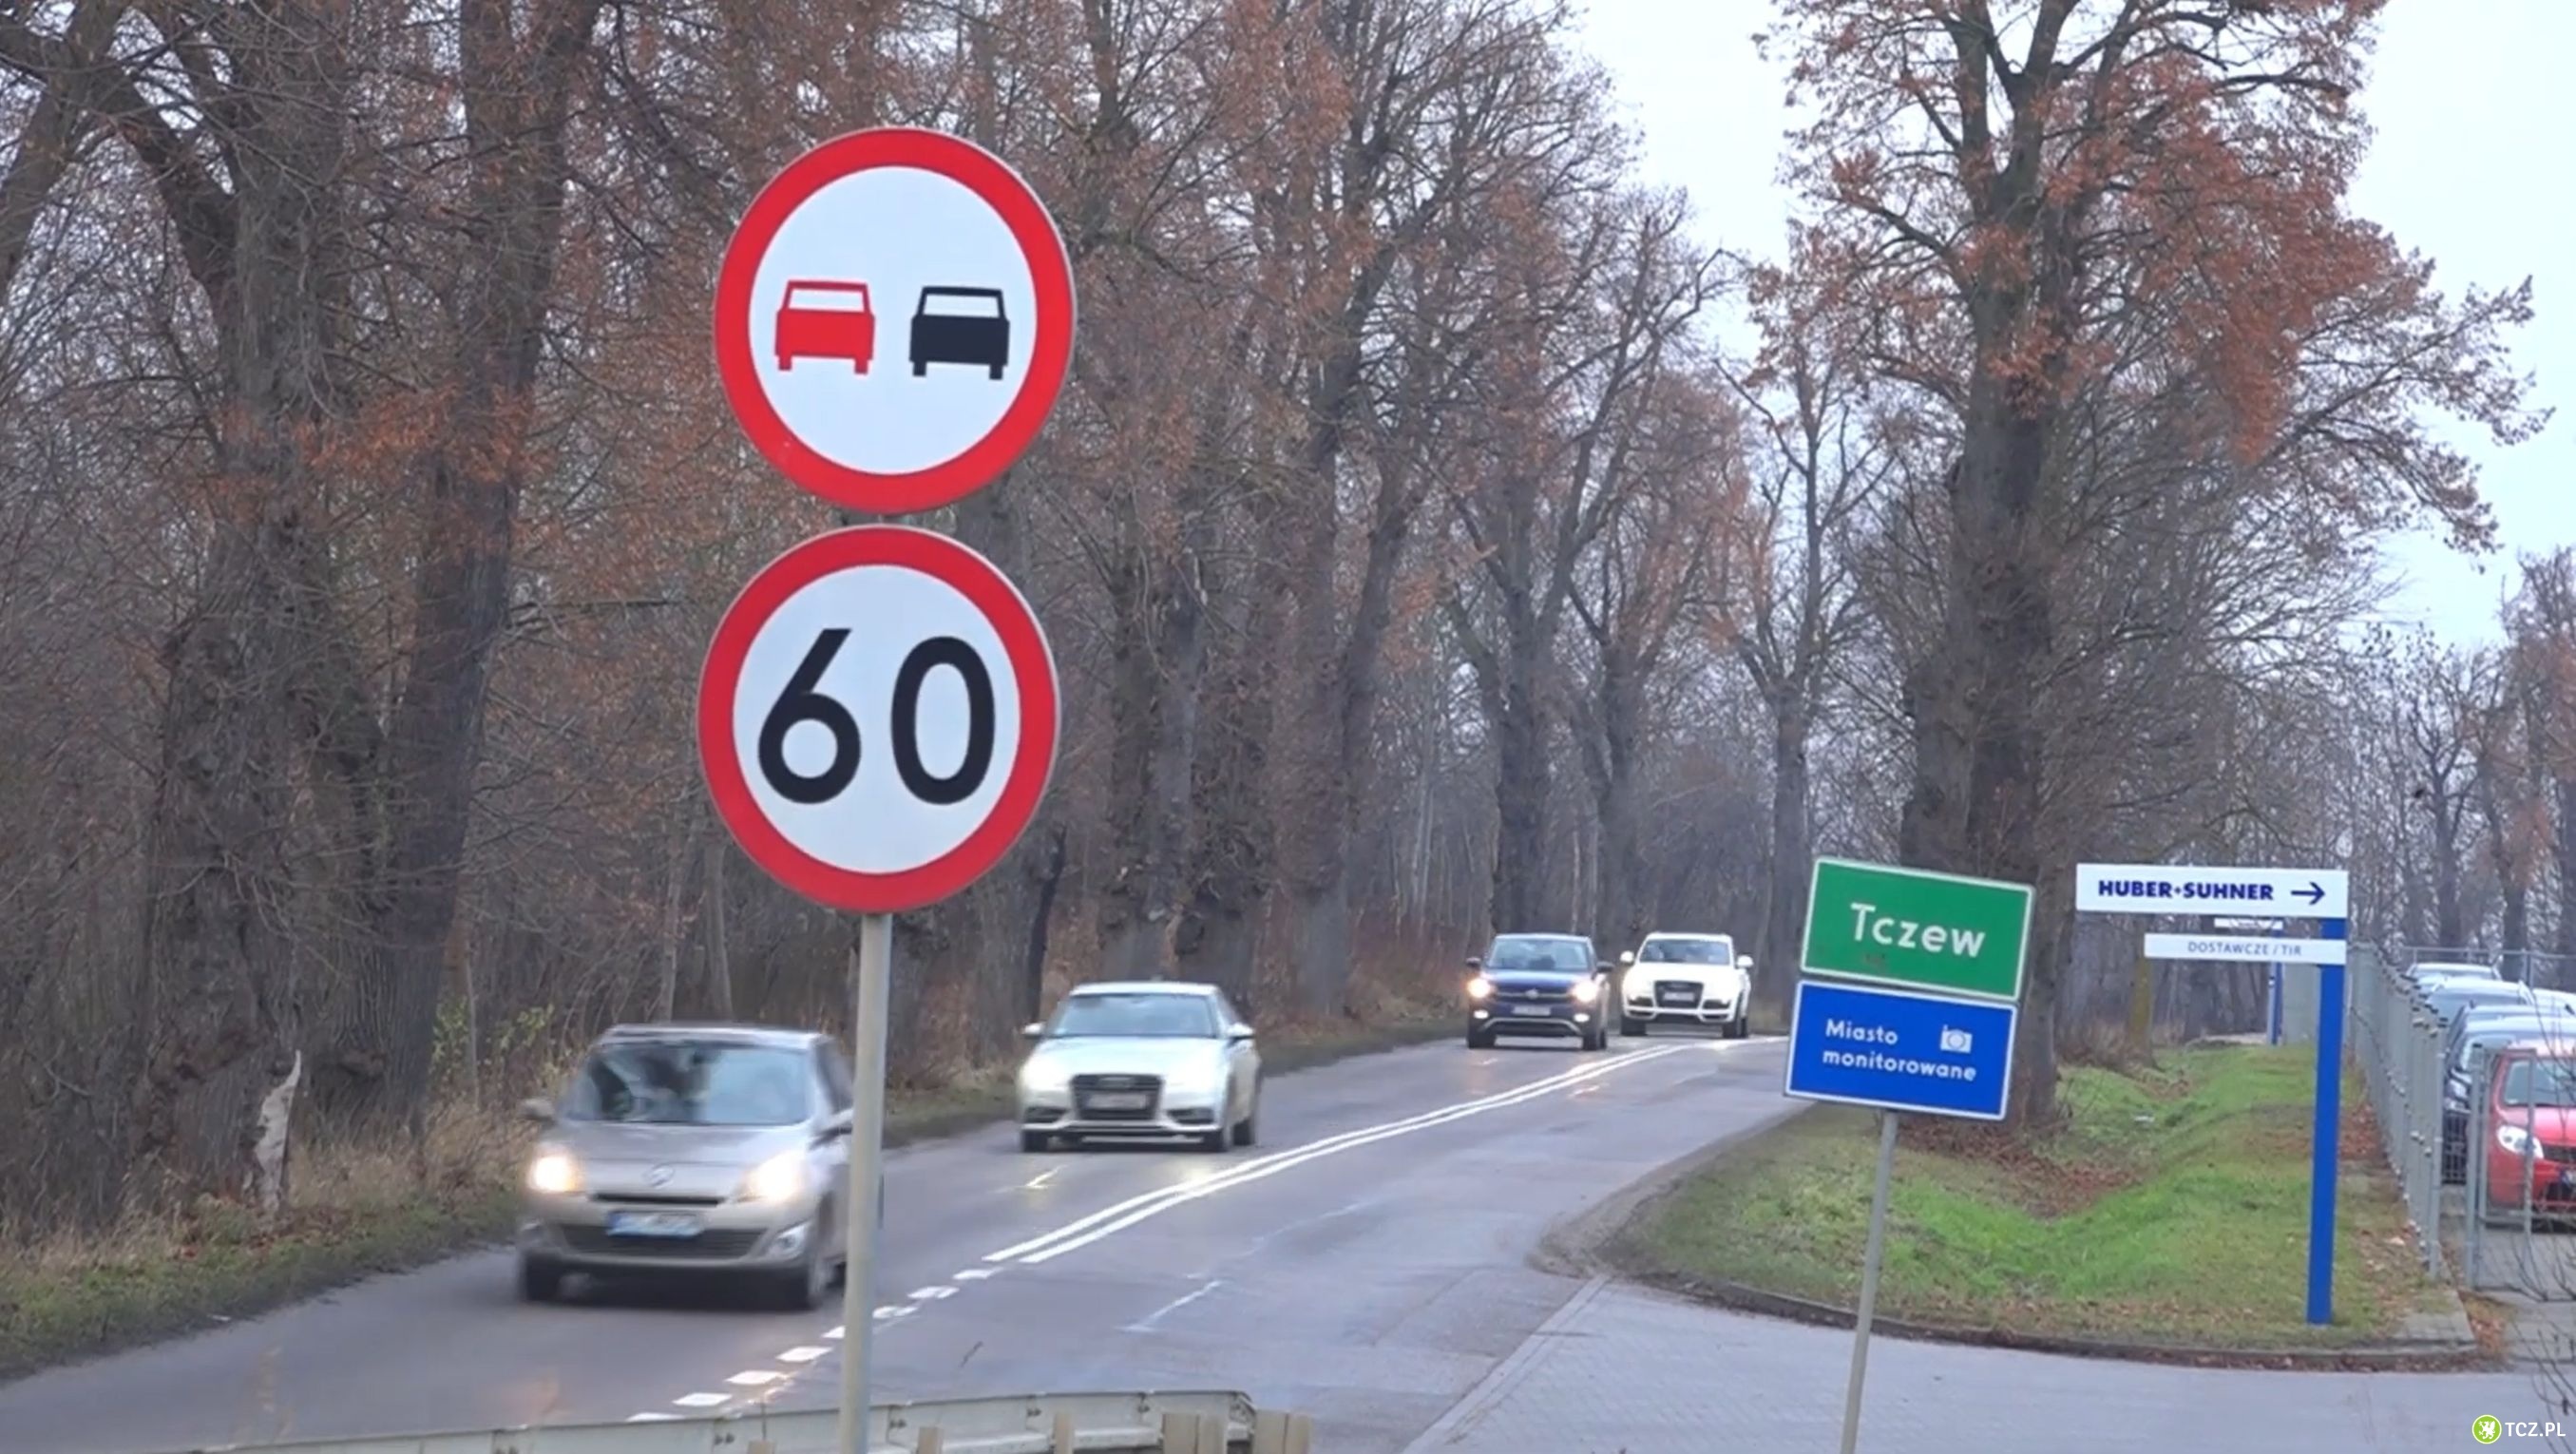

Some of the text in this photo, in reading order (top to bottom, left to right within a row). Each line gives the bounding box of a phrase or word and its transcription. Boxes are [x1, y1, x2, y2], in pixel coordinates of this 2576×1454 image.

[757, 627, 996, 806] 60
[1850, 902, 1986, 959] Tczew
[2187, 940, 2269, 956] DOSTAWCZE
[2281, 943, 2302, 957] TIR
[1824, 1018, 1899, 1045] Miasto
[1822, 1050, 1977, 1082] monitorowane
